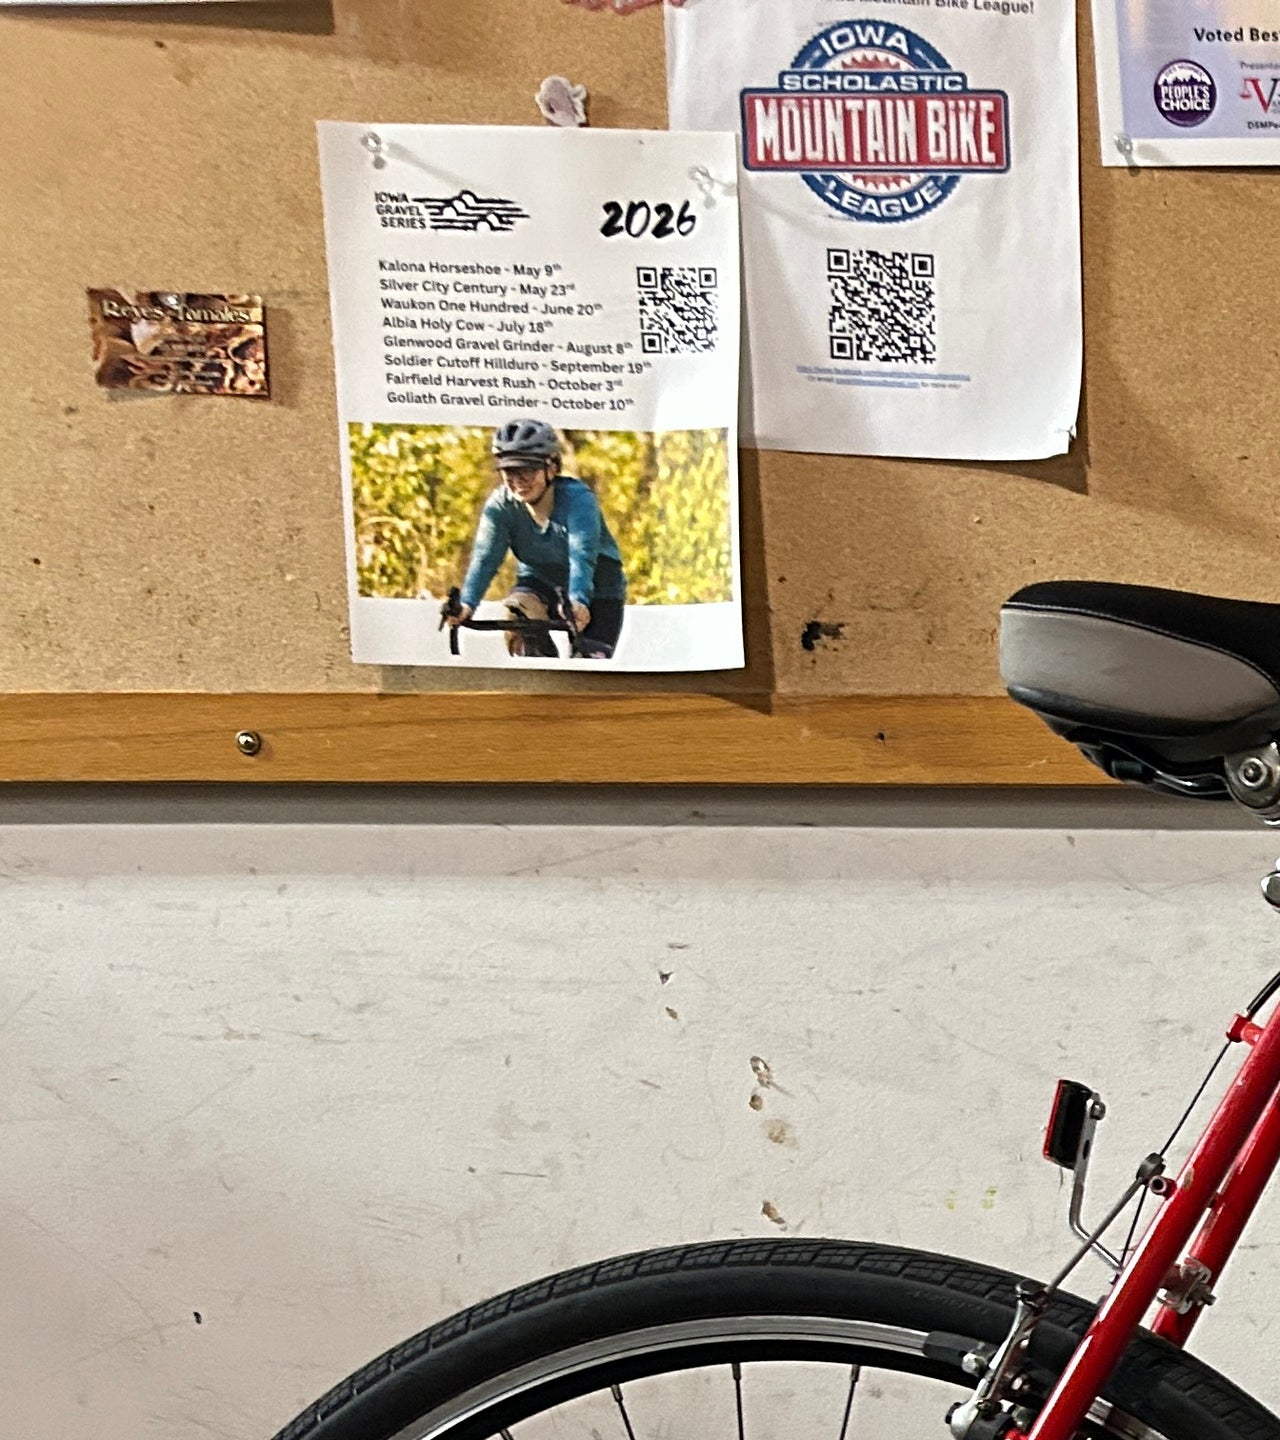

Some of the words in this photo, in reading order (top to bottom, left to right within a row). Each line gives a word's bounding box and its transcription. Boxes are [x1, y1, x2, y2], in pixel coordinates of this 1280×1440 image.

[973, 0, 1034, 15] League!
[820, 24, 910, 57] IOWA
[1194, 27, 1244, 42] Voted
[783, 75, 963, 91] SCHOLASTIC
[1161, 99, 1211, 111] CHOICE
[754, 98, 918, 163] MOUNTAIN
[374, 191, 409, 203] IOWA
[825, 180, 942, 218] LEAGUE
[376, 204, 423, 216] GRAVEL
[600, 200, 696, 238] 2026
[380, 217, 427, 229] SERIES
[378, 260, 426, 272] Kalona
[429, 262, 502, 275] Horseshoe
[513, 264, 541, 279] May
[380, 278, 419, 291] Silver
[422, 280, 450, 295] City
[453, 281, 507, 296] Century
[520, 284, 547, 298] May
[381, 298, 435, 310] Waukon
[439, 299, 466, 311] One
[470, 301, 529, 314] Hundred
[541, 303, 574, 315] June
[382, 317, 417, 329] Albia
[420, 318, 452, 333] Holy
[455, 319, 485, 331] Cow
[497, 321, 525, 335] July
[384, 335, 452, 349] Glenwood
[456, 338, 499, 350] Gravel
[503, 339, 554, 352] Grinder
[566, 342, 613, 357] August
[384, 354, 433, 366] Soldier
[437, 356, 480, 368] Cutoff
[484, 358, 539, 371] Hillduro
[551, 360, 624, 374] September
[386, 373, 442, 386] Fairfield
[446, 375, 499, 388] Harvest
[503, 377, 536, 389] Rush
[548, 379, 602, 391] October
[440, 393, 484, 406] Gravel
[488, 395, 539, 407] Grinder
[551, 397, 606, 410] October
